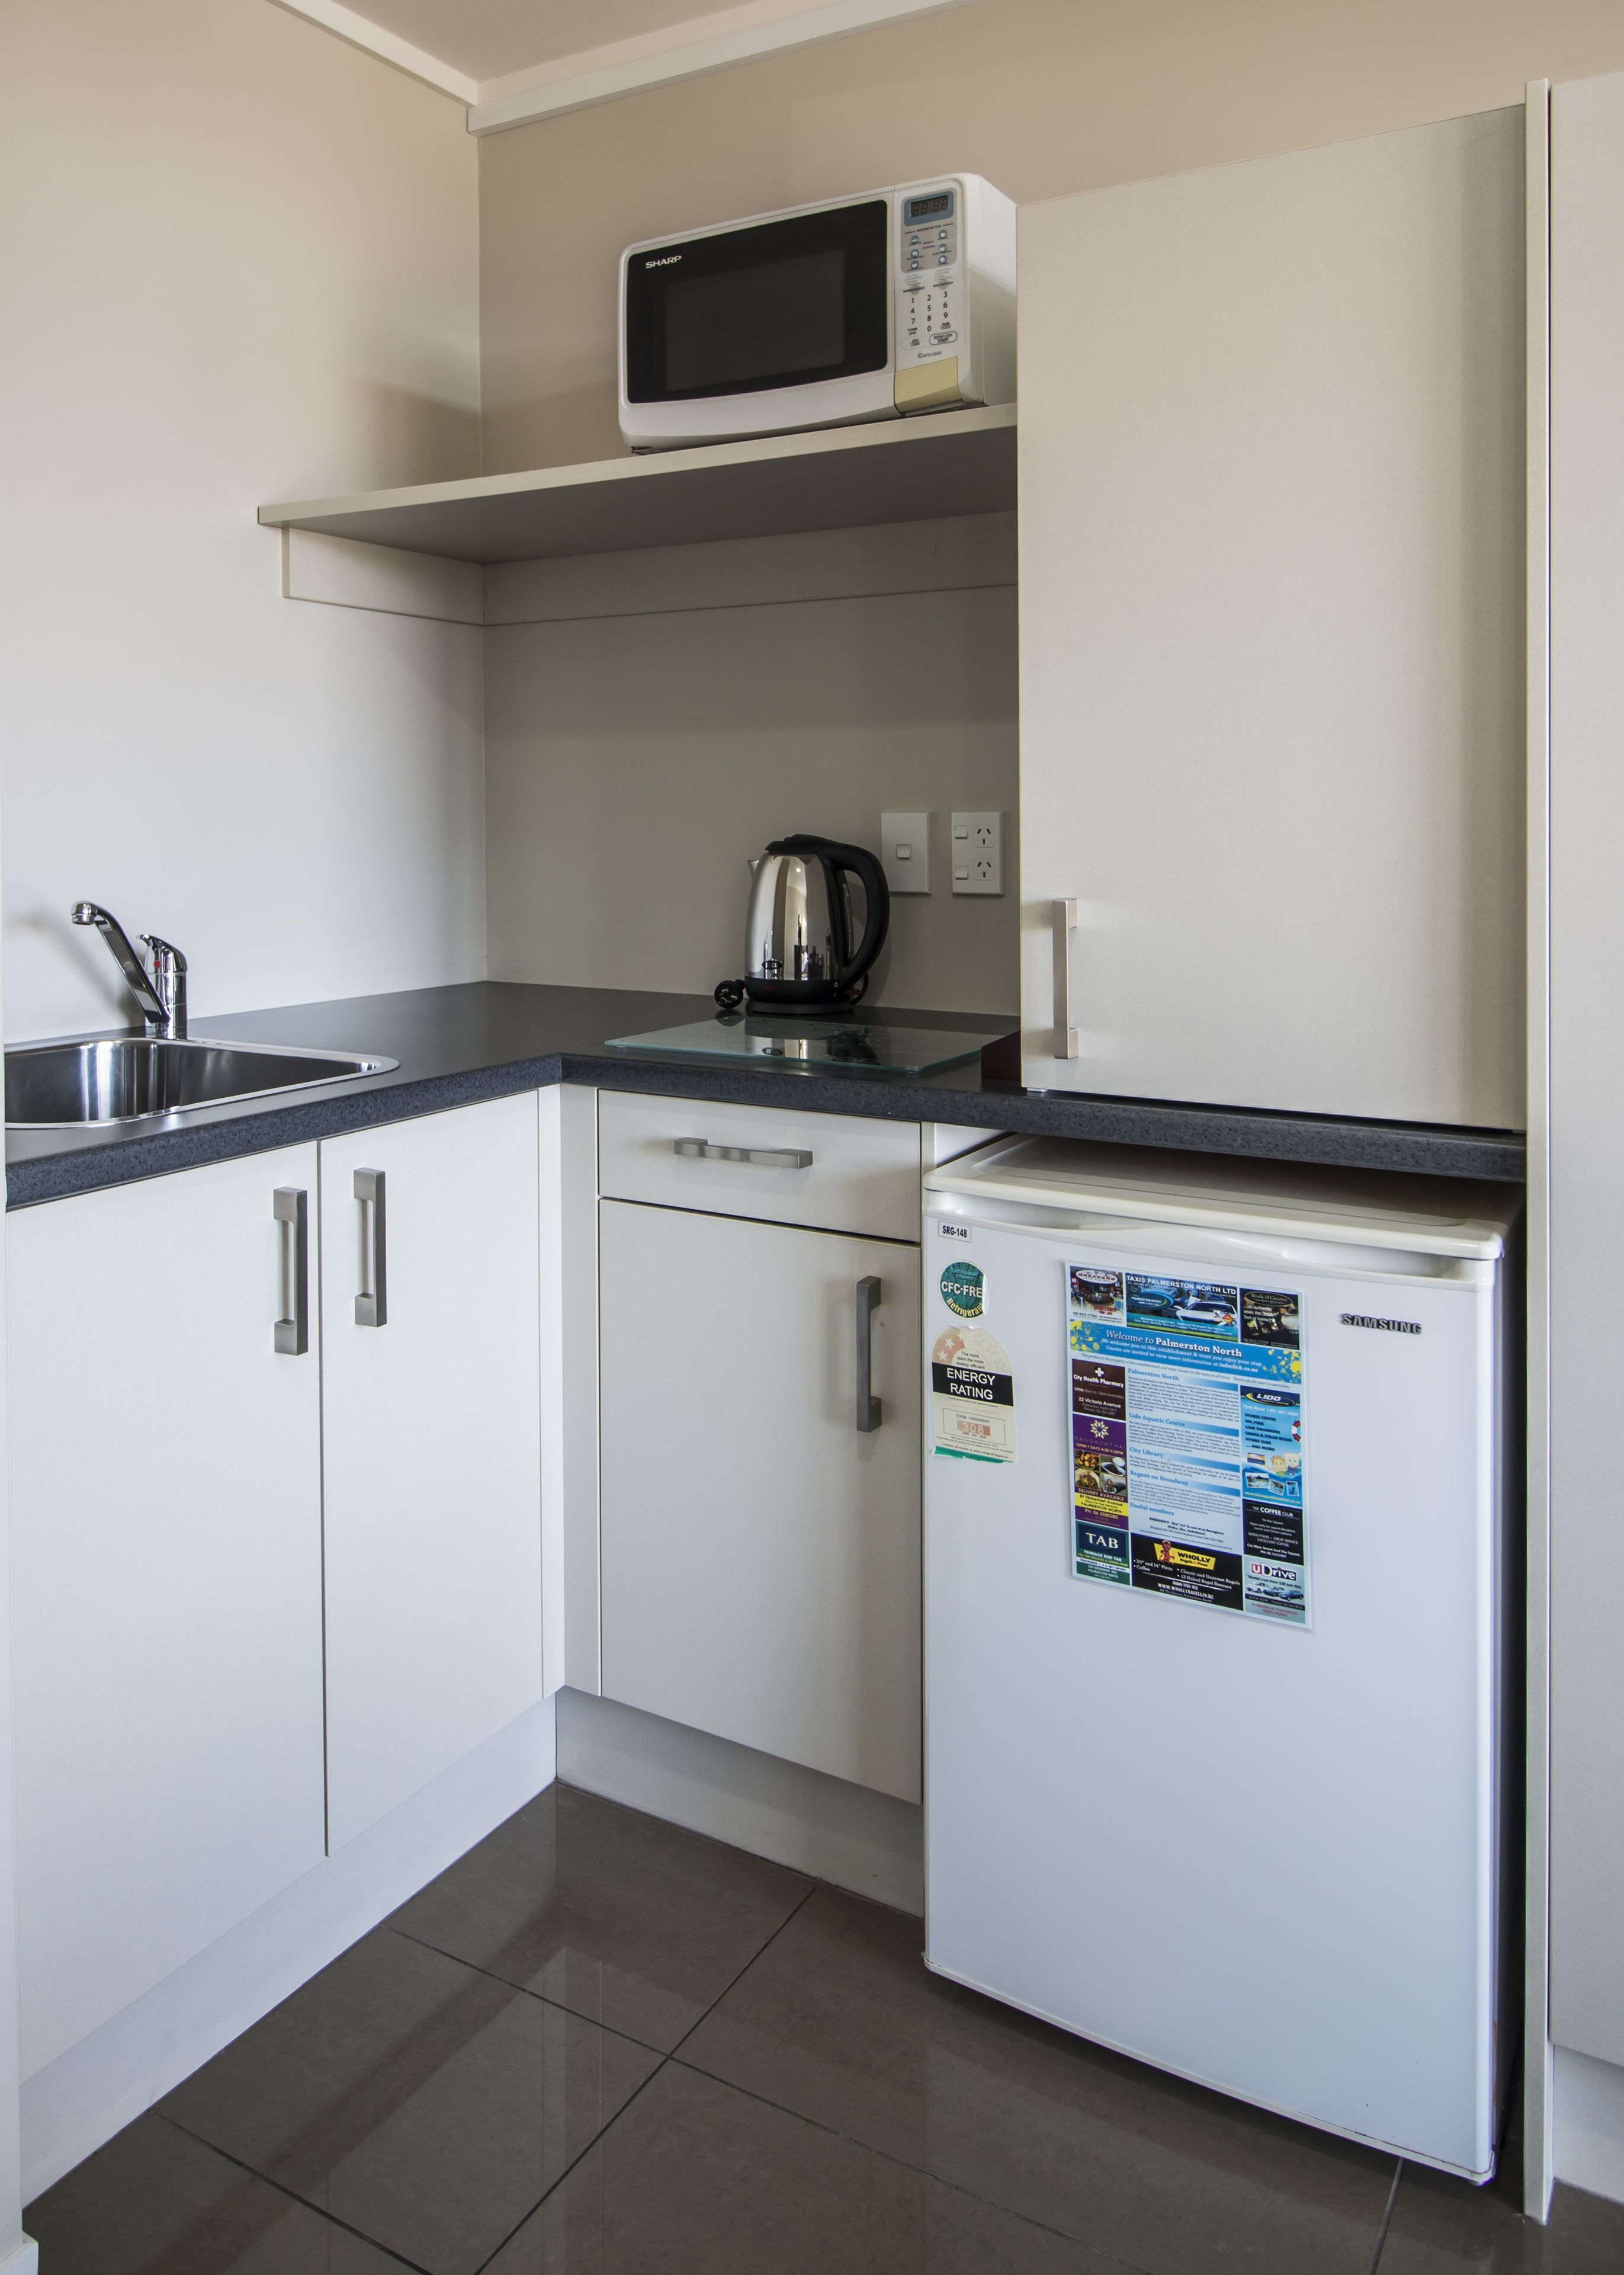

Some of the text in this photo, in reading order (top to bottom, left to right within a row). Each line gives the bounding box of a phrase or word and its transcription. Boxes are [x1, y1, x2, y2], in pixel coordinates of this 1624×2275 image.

[646, 255, 682, 268] SHARP
[942, 1225, 967, 1238] SRG-148
[1126, 1275, 1145, 1283] TAXIS
[1147, 1278, 1194, 1289] PALMERSTON
[941, 1281, 983, 1298] CFC-FRE
[1341, 1313, 1421, 1335] SAMSUNG
[1106, 1330, 1243, 1357] Welcome to Palmerston North
[1157, 1348, 1192, 1356] establishment
[1182, 1357, 1212, 1366] information
[947, 1367, 995, 1386] ENERGY
[1128, 1367, 1179, 1381] Palmerston North
[1100, 1379, 1124, 1388] Pharmacy
[951, 1383, 993, 1400] RATING
[1142, 1415, 1164, 1424] Aquatic
[1166, 1418, 1185, 1427] Centre
[962, 1422, 984, 1434] 308
[1142, 1448, 1164, 1458] Library
[1130, 1470, 1150, 1479] Regent
[1160, 1475, 1189, 1486] Broadway
[1100, 1493, 1124, 1501] AVAILABLE
[1081, 1502, 1107, 1511] PALMERSTON
[1129, 1502, 1175, 1516] Useful numbers
[1260, 1507, 1282, 1515] COFFEE
[1085, 1532, 1118, 1549] TAB
[1177, 1552, 1211, 1563] WHOLLY
[1252, 1563, 1296, 1579] uDrive
[1205, 1574, 1225, 1582] Gourmet
